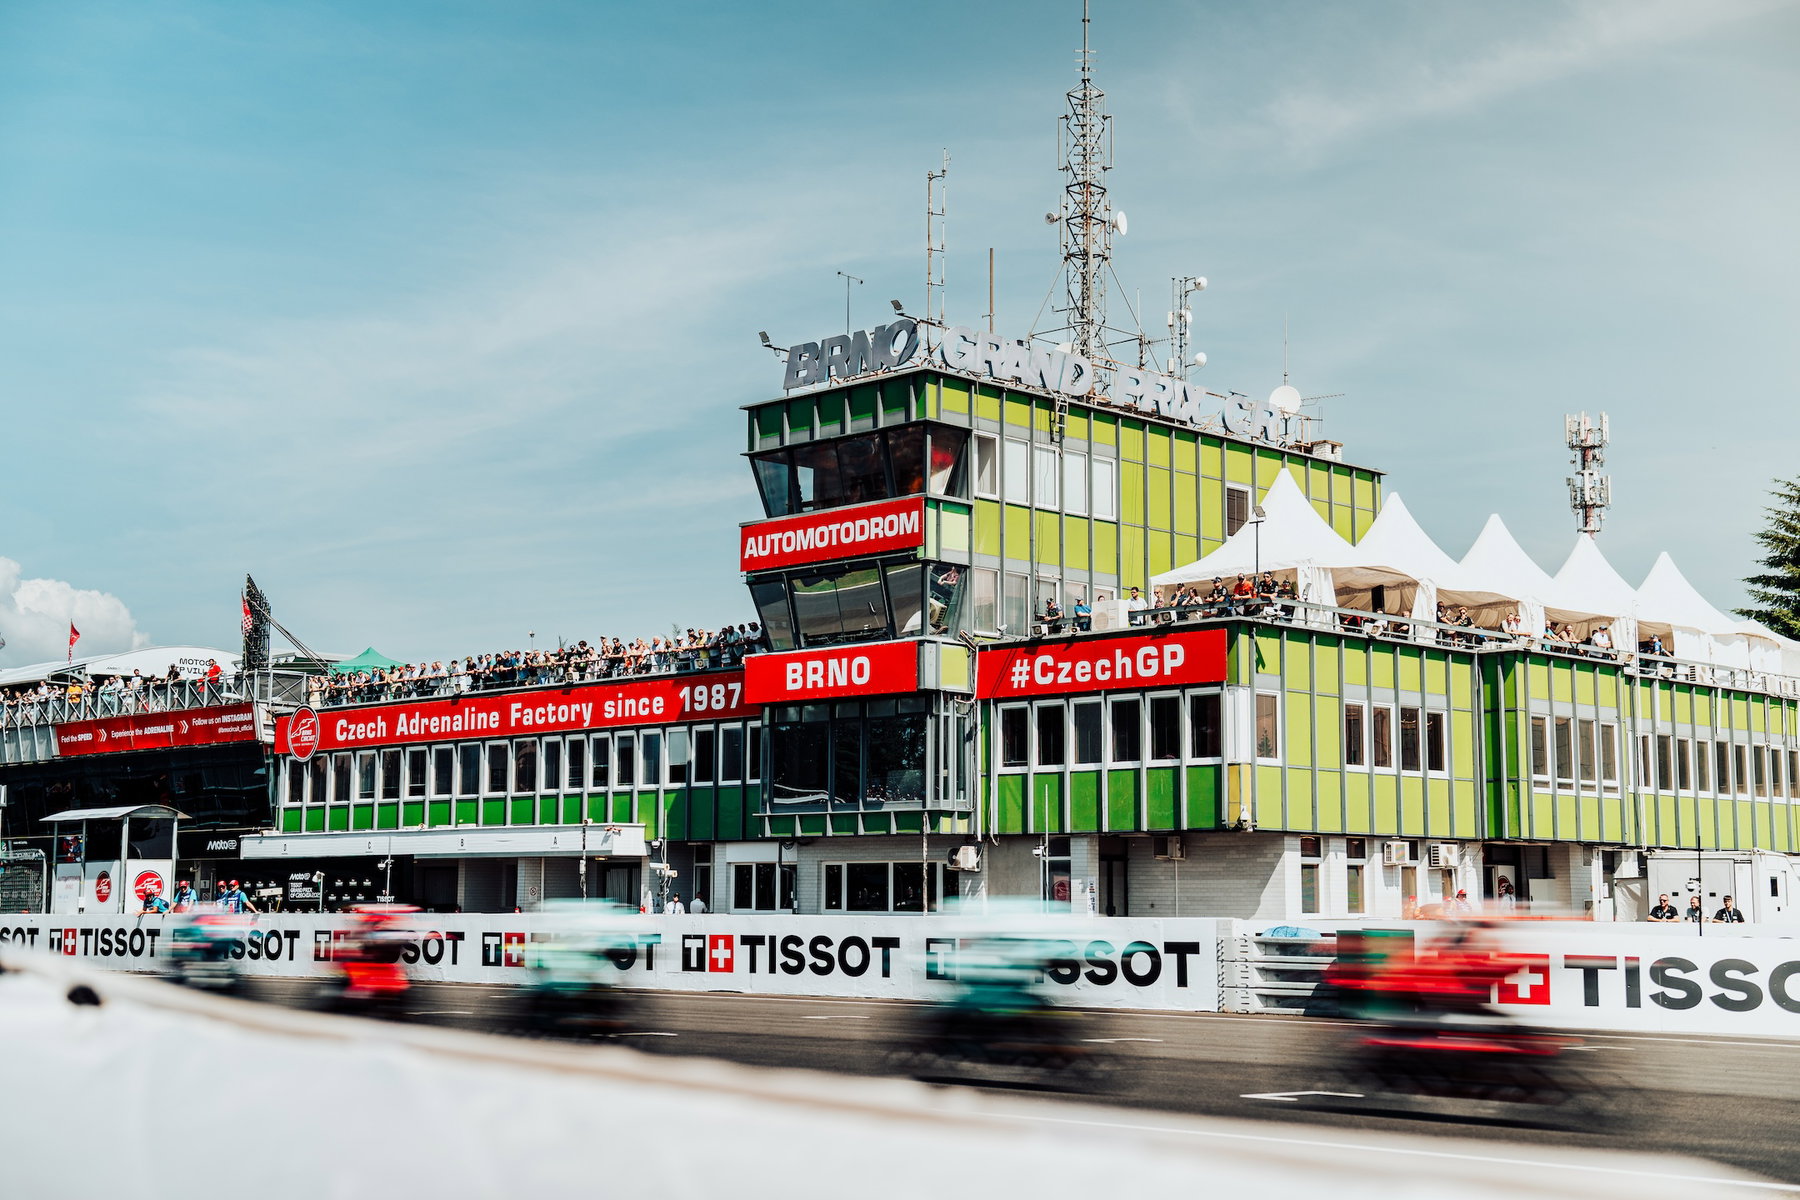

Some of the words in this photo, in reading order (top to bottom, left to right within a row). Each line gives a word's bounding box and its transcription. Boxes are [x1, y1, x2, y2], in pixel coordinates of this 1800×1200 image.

[783, 319, 920, 389] BRNO
[939, 326, 1094, 396] GRAND
[1112, 366, 1206, 425] PRIX
[744, 511, 919, 559] AUTOMOTODROM
[180, 657, 216, 667] MOTOG
[786, 656, 871, 690] BRNO
[1011, 644, 1185, 688] #CzechGP
[192, 717, 208, 726] Follow
[222, 713, 252, 723] INSTAGRAM
[336, 705, 387, 741] Czech
[396, 707, 500, 736] Adrenaline
[510, 703, 593, 727] Factory
[604, 693, 664, 718] since
[679, 682, 742, 712] 1987
[61, 735, 71, 743] Feel
[78, 733, 93, 742] SPEED
[111, 730, 135, 740] Experience
[143, 725, 174, 735] ADRENALINE
[554, 836, 558, 845] A
[80, 928, 161, 957] TISSOT
[740, 934, 900, 978] TISSOT
